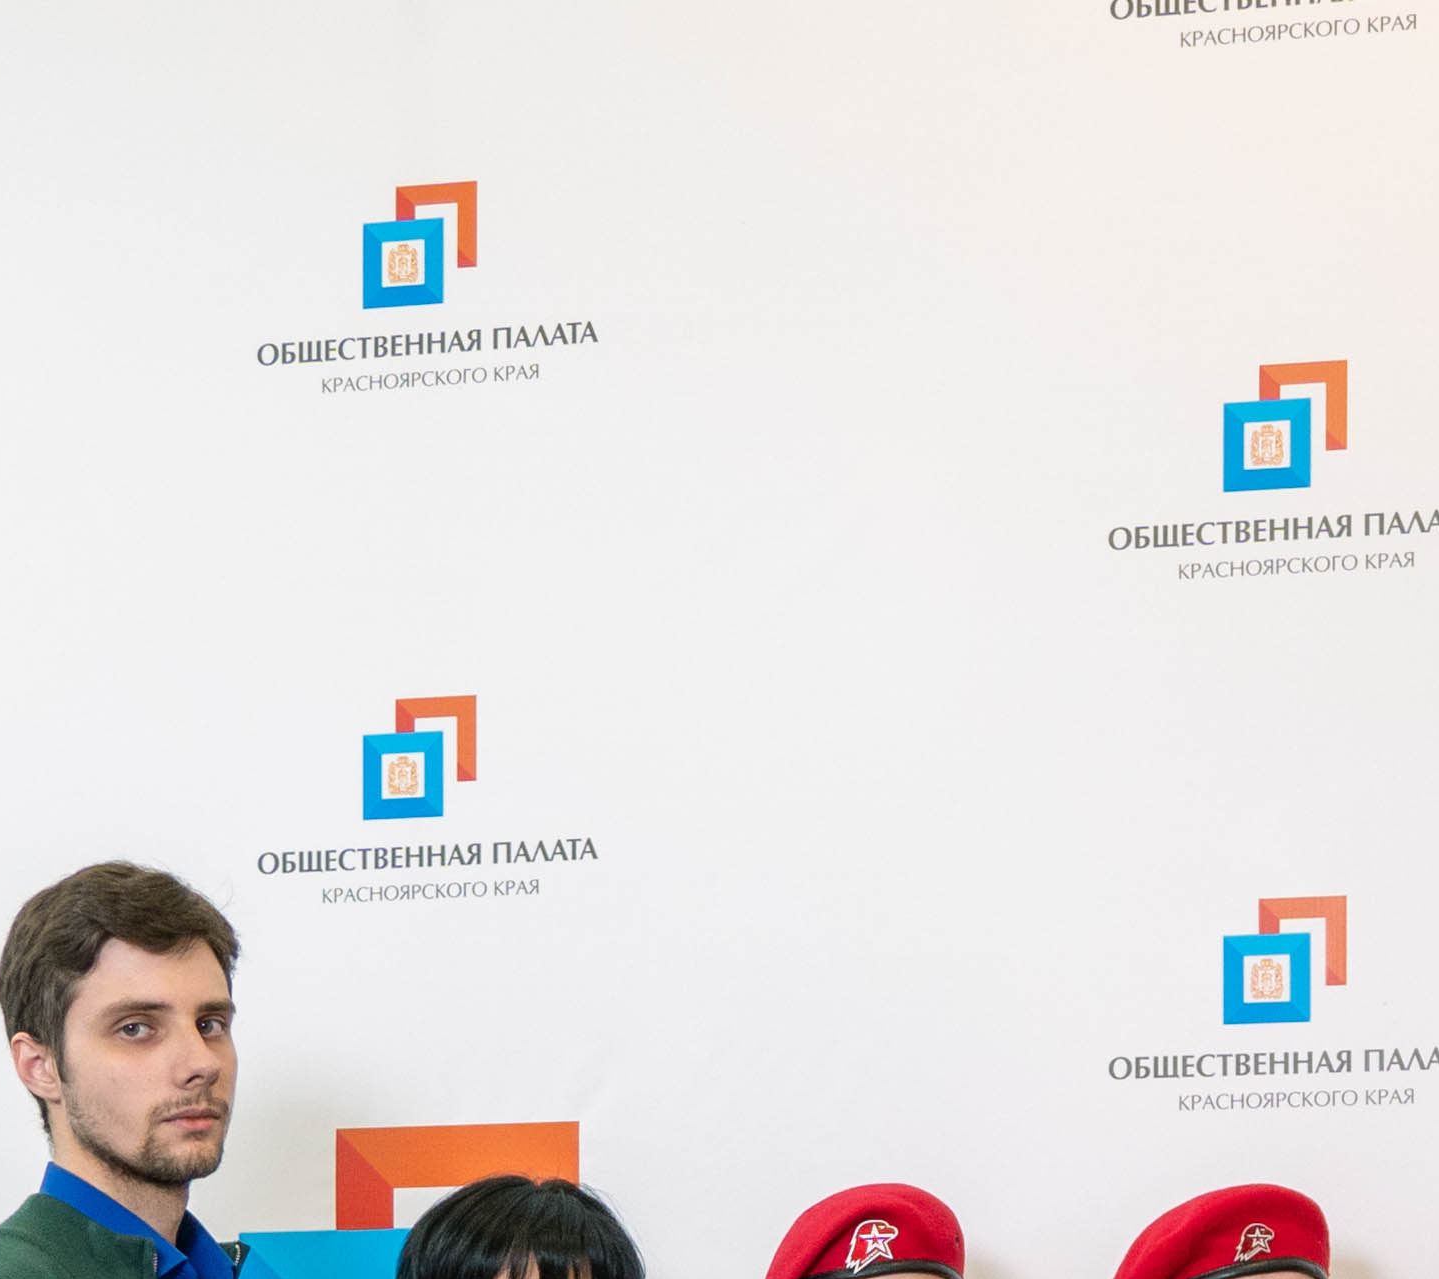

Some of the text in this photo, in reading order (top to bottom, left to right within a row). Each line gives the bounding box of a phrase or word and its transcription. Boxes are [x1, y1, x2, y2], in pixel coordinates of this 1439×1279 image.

[1180, 14, 1418, 48] КРАСНОЯРСКОГО КРАЯ
[257, 321, 599, 366] ОБЩЕСТВЕННАЯ ПАЛАТА
[321, 363, 540, 394] КРАСНОЯРСКОГО КРАЯ
[1108, 514, 1353, 551] ОБЩЕСТВЕННАЯ
[1178, 552, 1415, 580] КРАСНОЯРСКОГО КРАЯ
[257, 837, 599, 875] ОБЩЕСТВЕННАЯ ПАЛАТА
[321, 879, 540, 904] КРАСНОЯРСКОГО КРАЯ
[1108, 1050, 1353, 1080] ОБЩЕСТВЕННАЯ
[1178, 1088, 1415, 1112] КРАСНОЯРСКОГО КРАЯ
